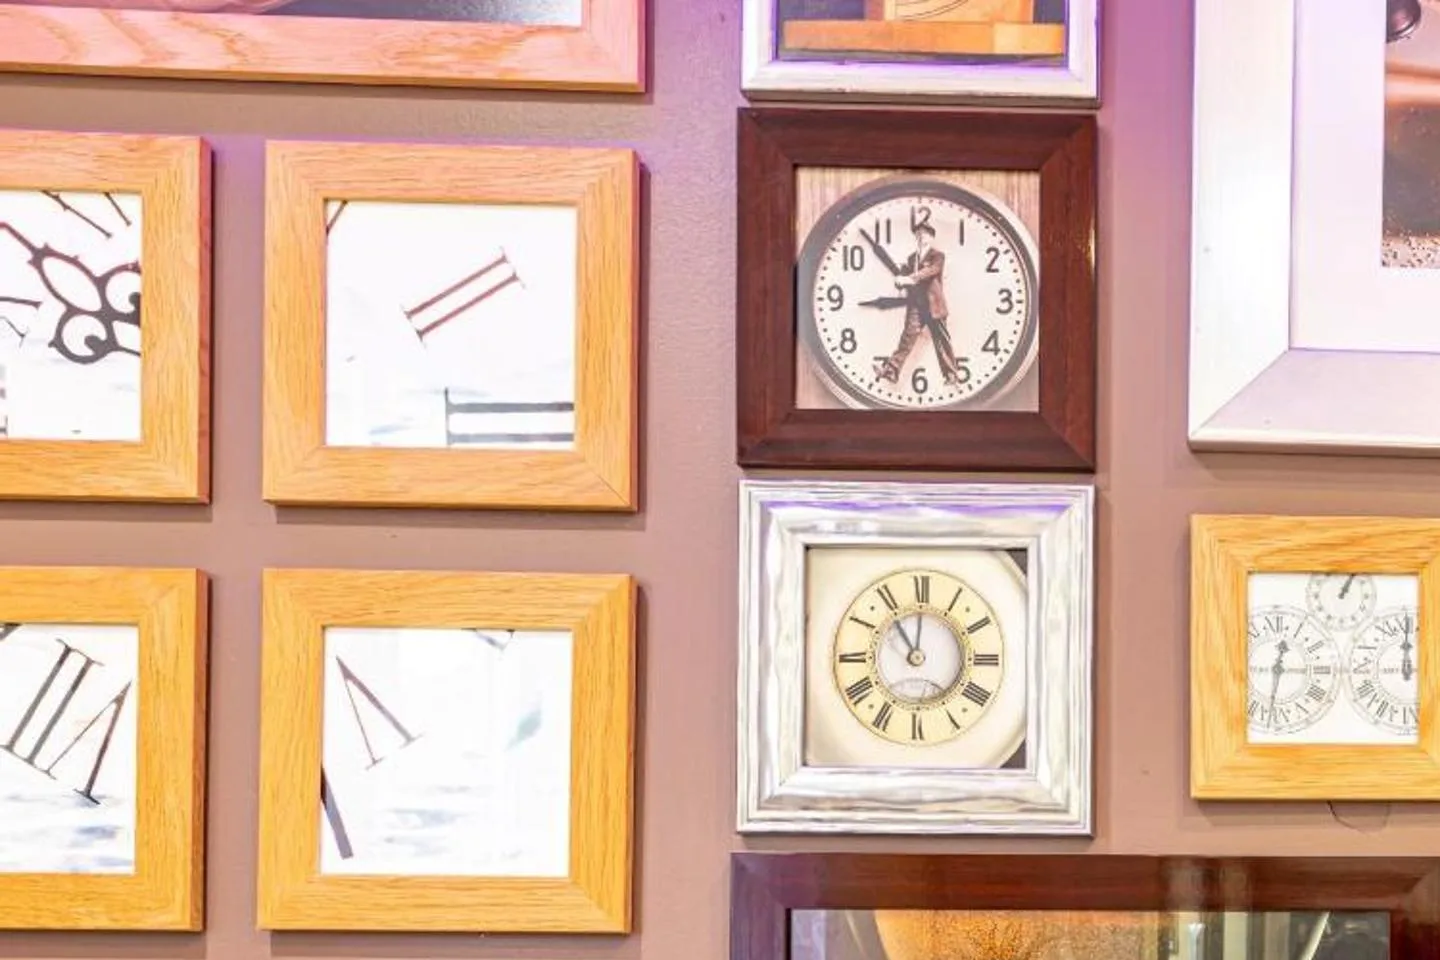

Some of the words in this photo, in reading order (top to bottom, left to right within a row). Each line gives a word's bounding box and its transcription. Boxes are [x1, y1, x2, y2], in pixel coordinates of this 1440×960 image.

[874, 218, 892, 244] 11
[958, 219, 965, 246] 1
[843, 246, 865, 272] 10
[985, 248, 1001, 274] 2
[827, 285, 844, 312] 9
[995, 288, 1013, 315] 3
[840, 328, 857, 354] 8
[981, 330, 1003, 356] 4
[911, 367, 928, 394] 6
[954, 356, 971, 384] 5
